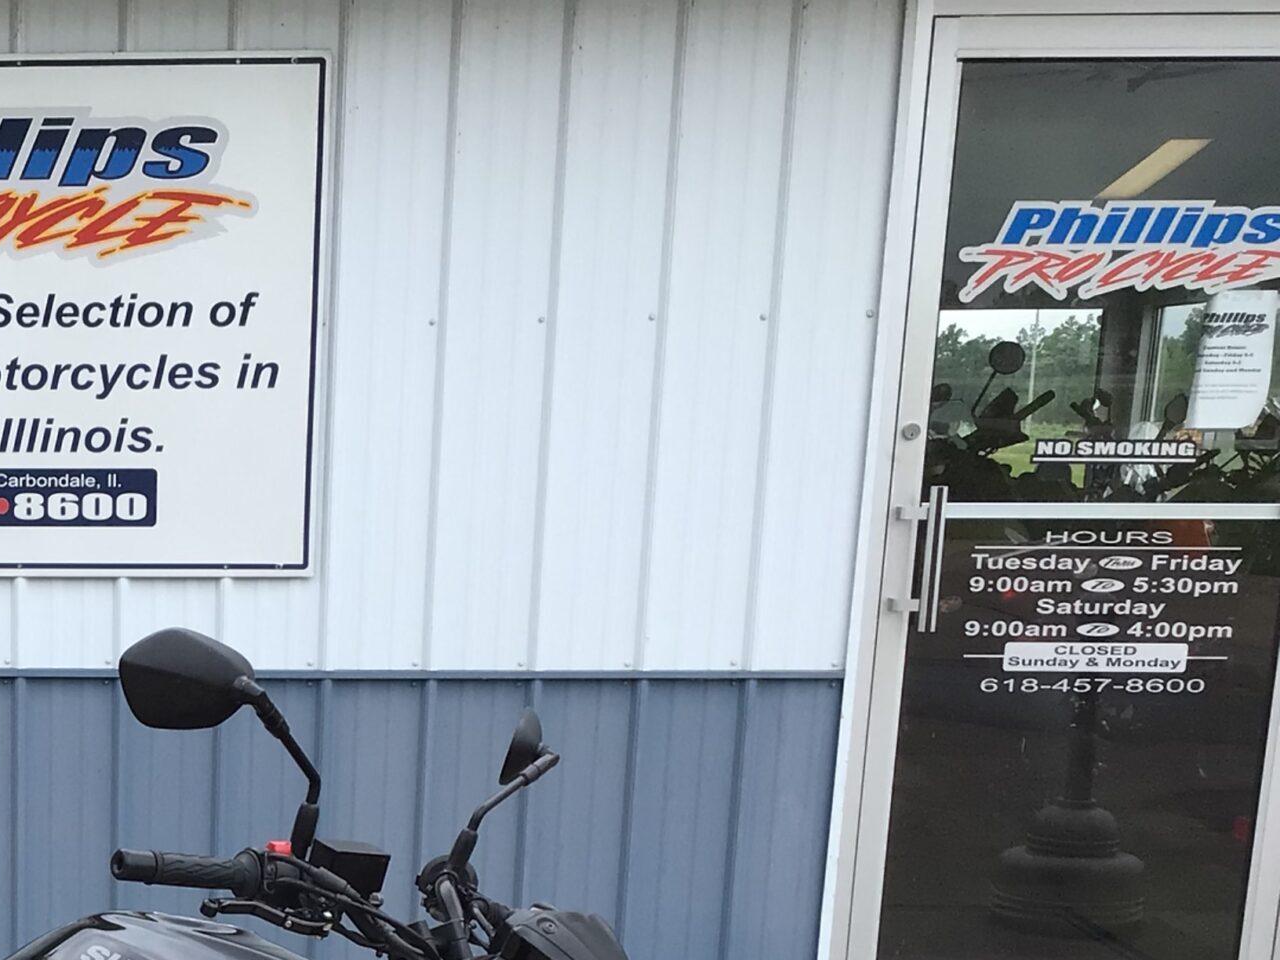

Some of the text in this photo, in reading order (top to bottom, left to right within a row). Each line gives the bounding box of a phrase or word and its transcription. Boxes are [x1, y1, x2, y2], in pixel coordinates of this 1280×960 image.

[1002, 207, 1280, 247] Phillips
[965, 249, 1108, 296] PRO
[210, 291, 259, 328] of
[237, 353, 279, 389] in
[1037, 441, 1195, 456] NO SMOKING
[1045, 531, 1174, 544] HOURS
[971, 554, 1091, 574] Tuesday
[1151, 555, 1243, 575] Friday
[969, 577, 1072, 593] 9:00am
[1132, 577, 1239, 597] 5:30pm
[1036, 598, 1166, 619] Saturday
[965, 621, 1067, 637] 9:00am
[1127, 621, 1233, 641] 4:00pm
[1054, 645, 1137, 656] CLOSED
[1008, 656, 1181, 670] Sunday & Monday
[980, 678, 1206, 693] 618-457-8600
